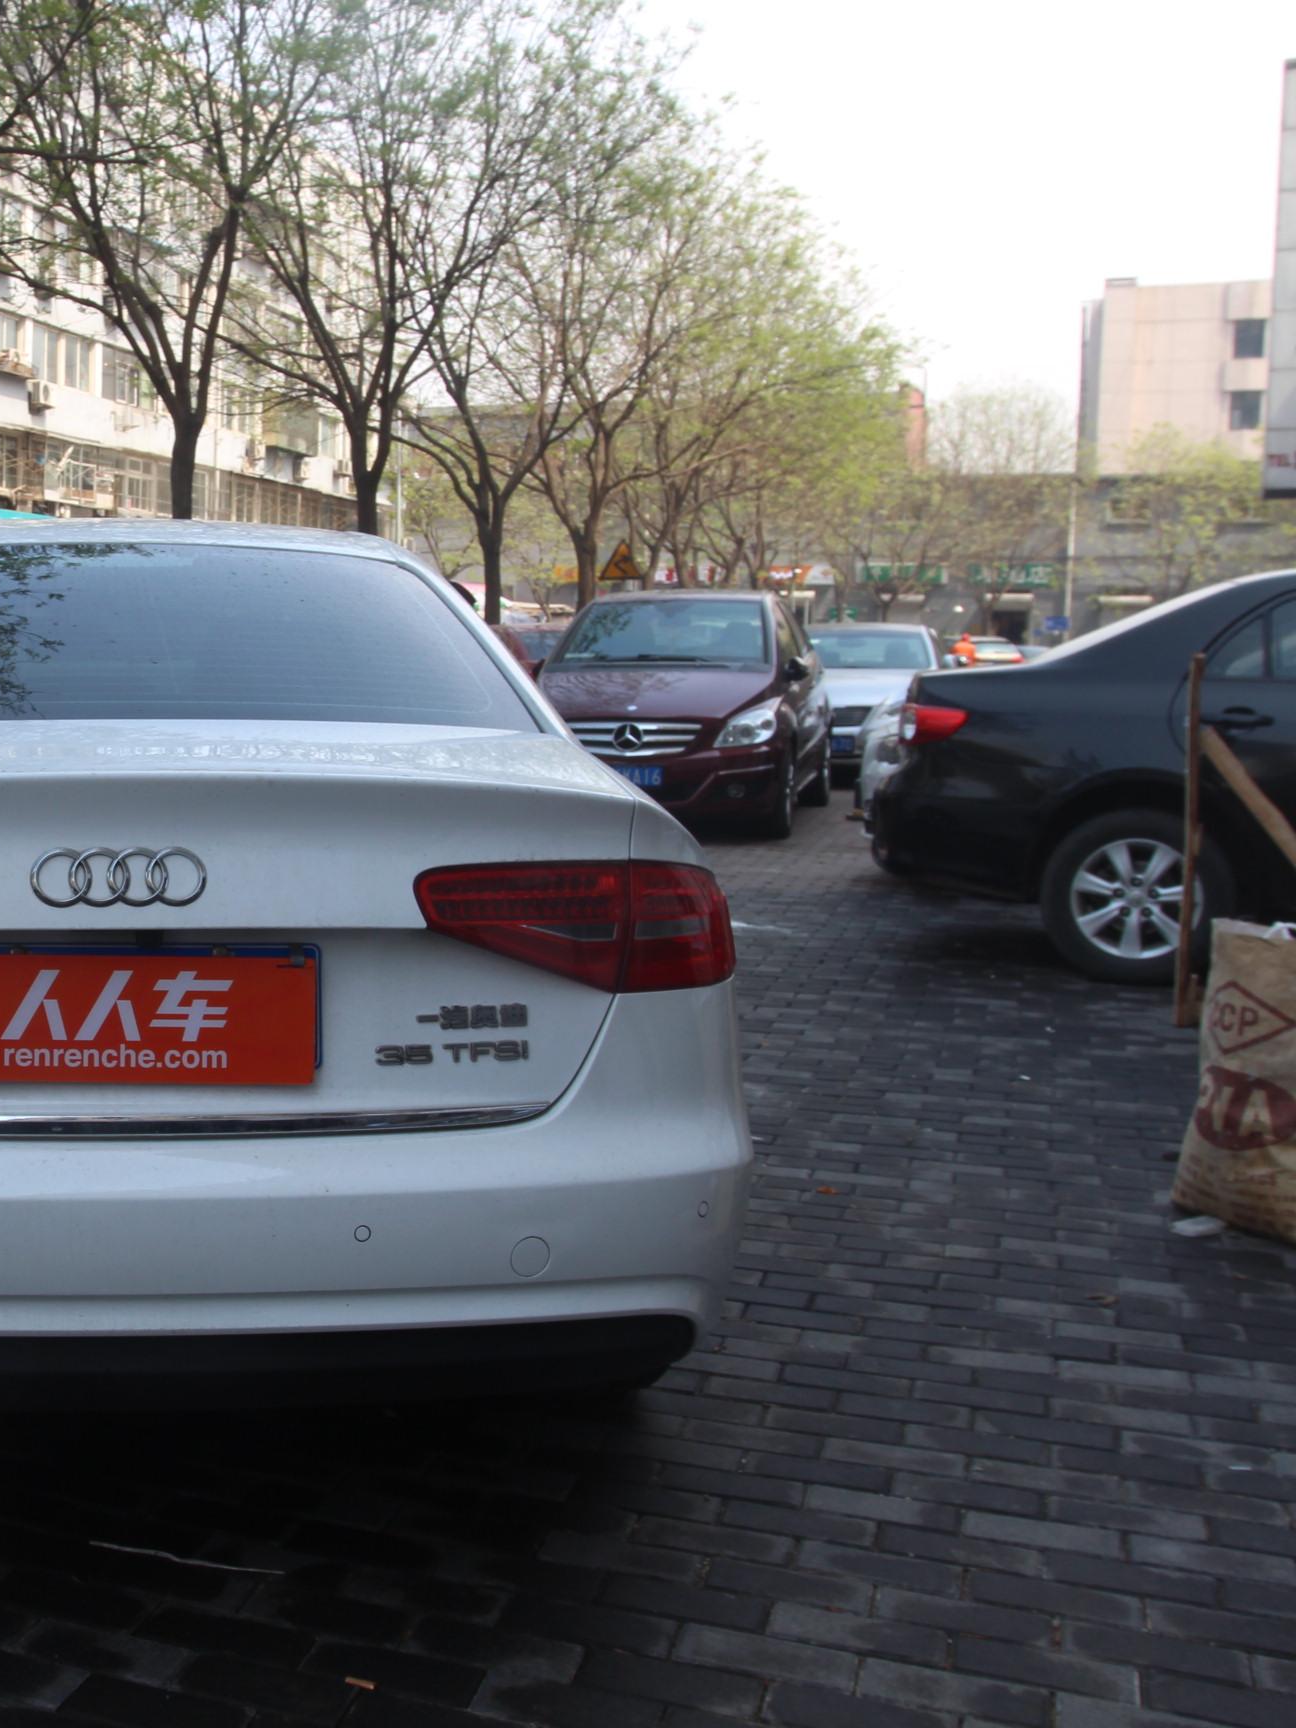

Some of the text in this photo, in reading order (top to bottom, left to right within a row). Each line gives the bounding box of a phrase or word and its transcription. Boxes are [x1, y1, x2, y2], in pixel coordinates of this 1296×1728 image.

[0, 969, 234, 1042] 人人车
[416, 1003, 528, 1030] 一汽奥迪
[3, 1044, 227, 1069] renrenche.com
[375, 1040, 529, 1066] 35 TFSI
